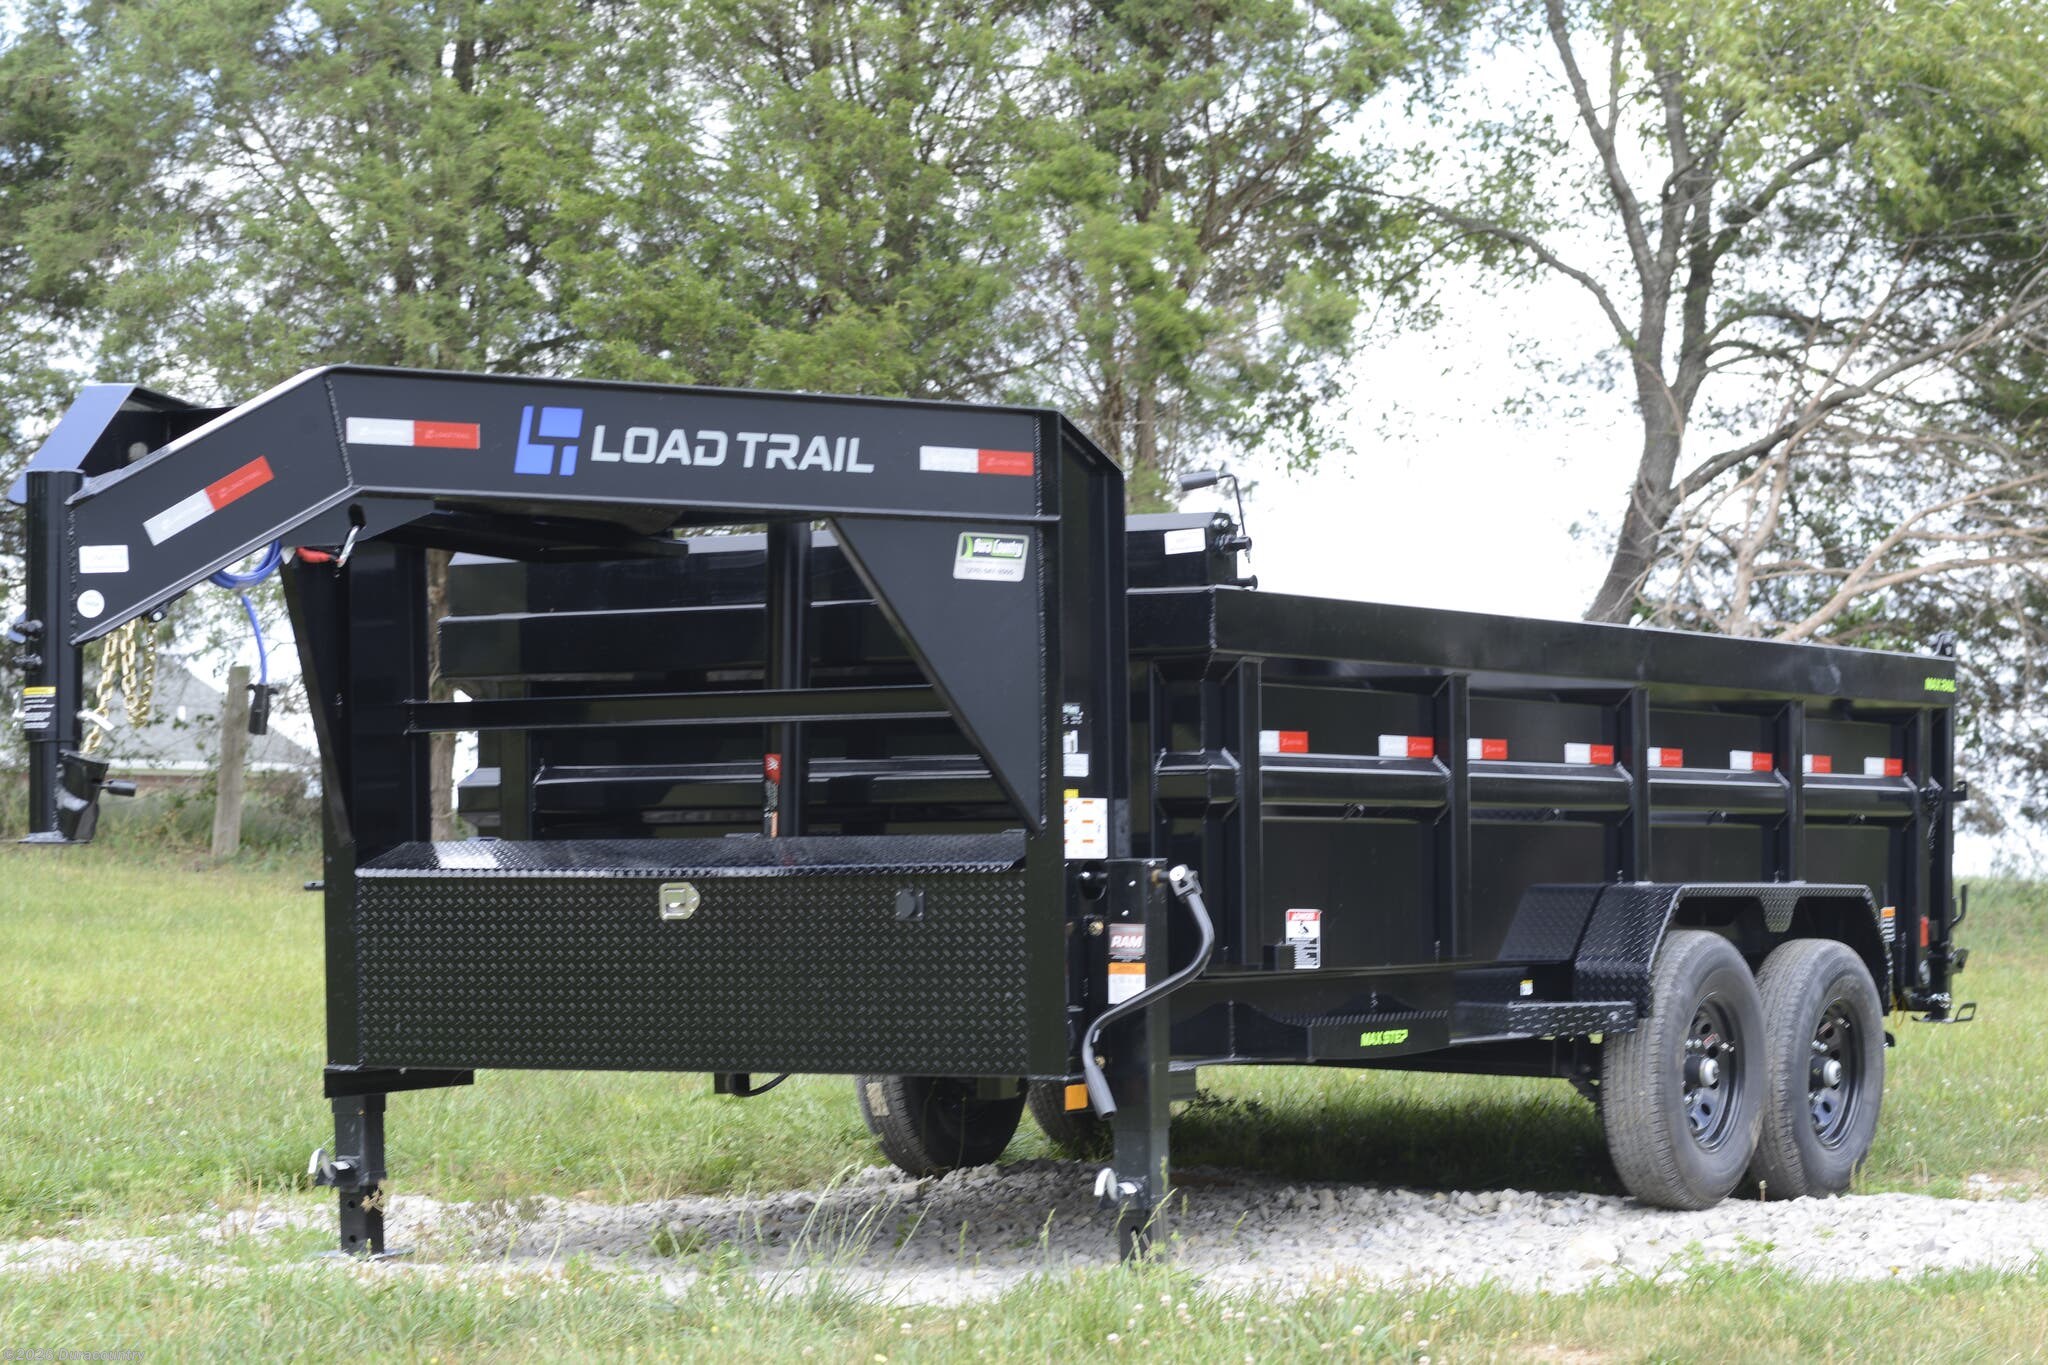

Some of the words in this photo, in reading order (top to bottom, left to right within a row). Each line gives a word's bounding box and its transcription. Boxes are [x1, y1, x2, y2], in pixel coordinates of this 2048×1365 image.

[591, 425, 729, 467] LOAD
[736, 432, 875, 473] TRAIL
[1110, 935, 1144, 948] RAM
